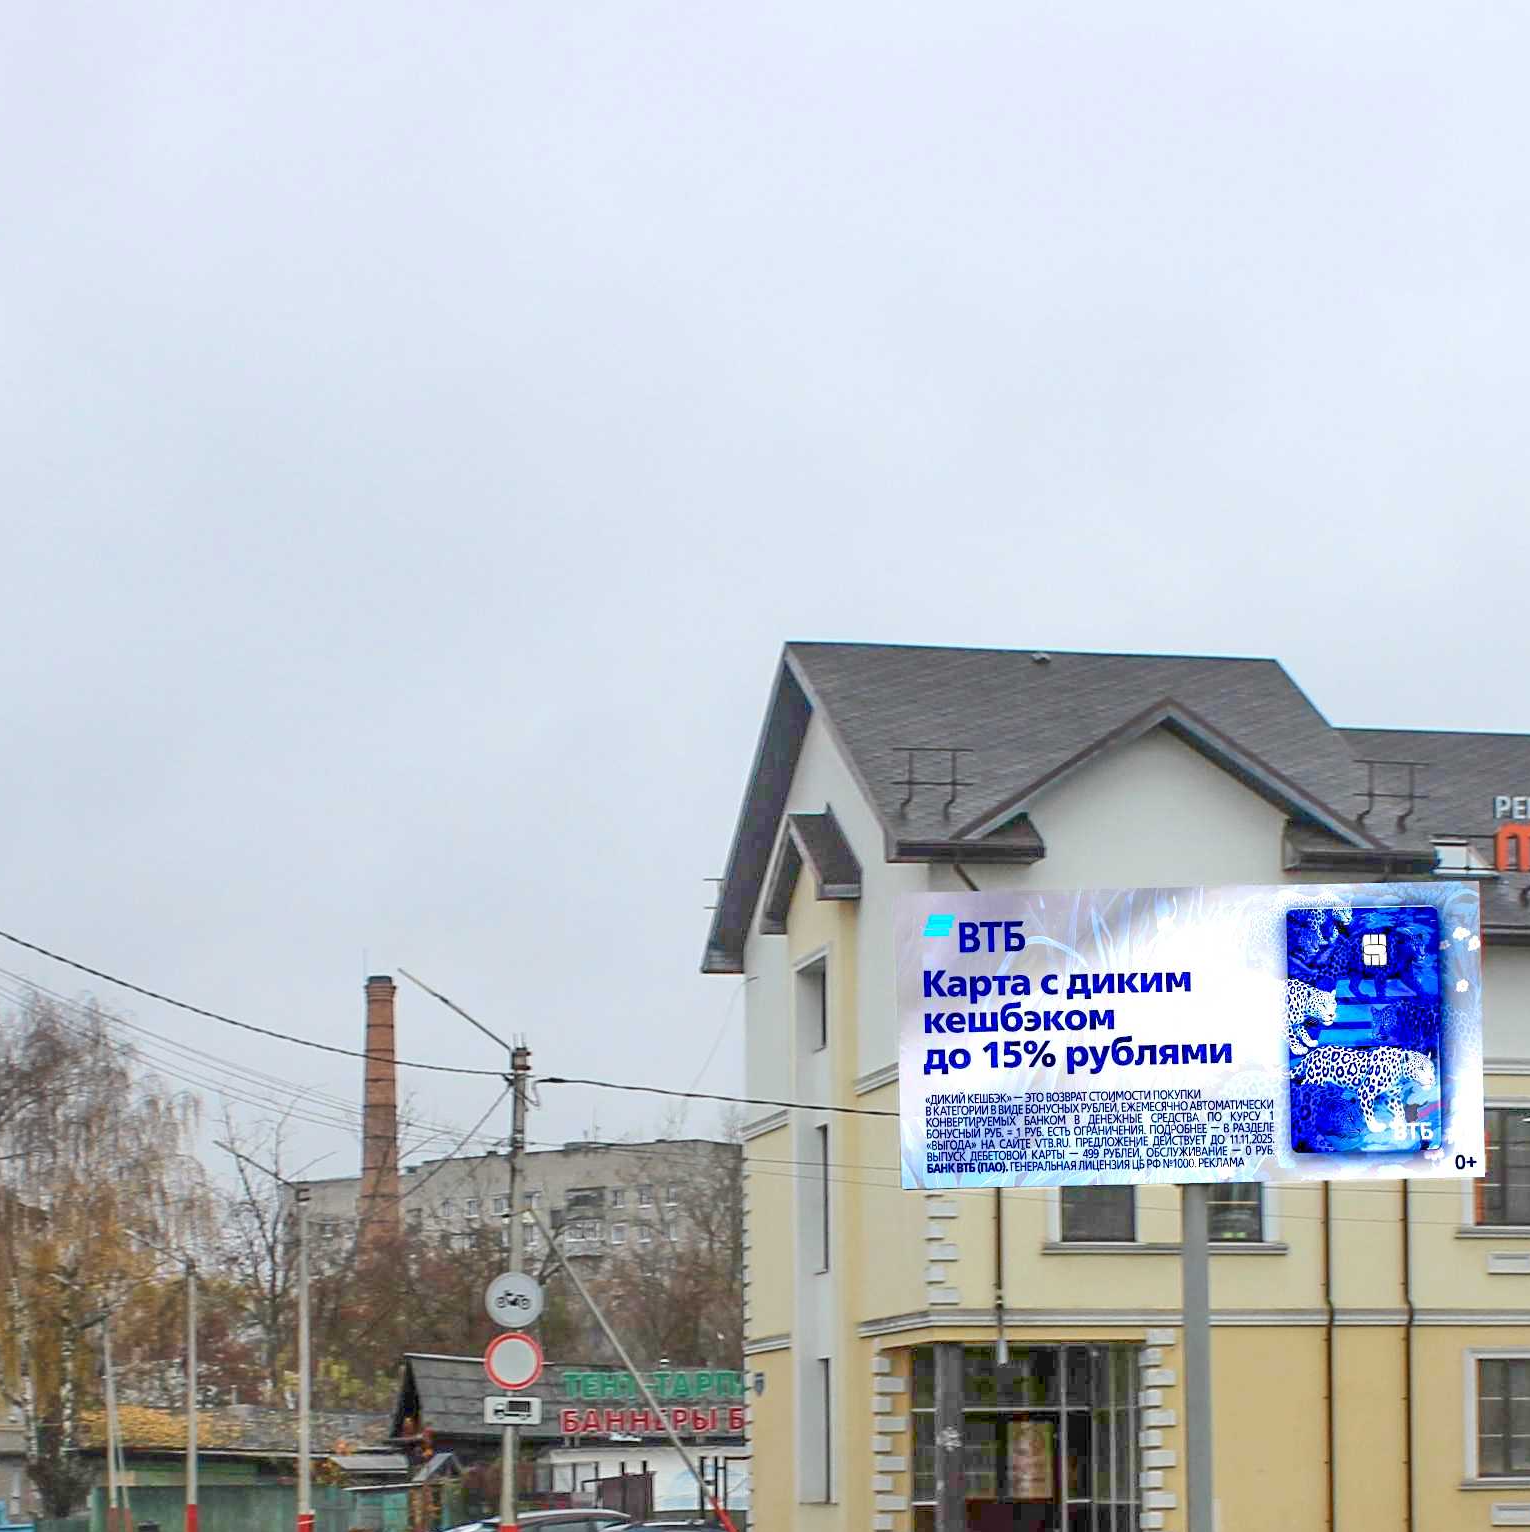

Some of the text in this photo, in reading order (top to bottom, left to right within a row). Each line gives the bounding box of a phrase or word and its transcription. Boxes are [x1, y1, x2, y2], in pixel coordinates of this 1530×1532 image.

[959, 920, 1026, 953] ВТБ
[923, 969, 1191, 1004] Карта с диким
[923, 1001, 1115, 1034] кешбэком
[923, 1035, 1233, 1075] до 15% рублями
[925, 1092, 966, 1105] «ДИКИЙ
[968, 1093, 1011, 1104] КЕШБЭК»
[1025, 1092, 1044, 1102] ЭТО
[1046, 1092, 1087, 1102] ВОЗВРАТ
[1089, 1090, 1150, 1102] СТОИМОСТИ
[1153, 1089, 1201, 1100] ПОКУПКИ
[925, 1100, 1274, 1116] В КАТЕГОРИИ В ВИДЕ БОНУСНЫХ РУБЛЕЙ, ЕЖЕМЕСЯЧНО АВТОМАТИЧЕСКИ
[926, 1111, 1274, 1128] КОНВЕРТИРУЕМЫХ БАНКОМ В ДЕНЕЖНЫЕ СРЕДСТВА ПО КУРСУ 1
[926, 1127, 981, 1139] БОНУСНЫЙ
[984, 1127, 1004, 1138] РУБ.
[1024, 1127, 1044, 1137] РУБ.
[1048, 1126, 1070, 1137] ЕСТЬ
[1074, 1124, 1146, 1136] ОГРАНИЧЕНИЯ.
[1149, 1123, 1207, 1136] ПОДРОБНЕЕ
[1223, 1123, 1229, 1133] В
[1233, 1122, 1275, 1134] РАЗДЕЛЕ
[1393, 1121, 1434, 1140] ВТБ
[926, 1139, 976, 1151] «ВЫГОДА»
[981, 1139, 995, 1149] НА
[999, 1136, 1031, 1149] САЙТЕ
[1035, 1137, 1071, 1148] VTB.RU.
[1075, 1136, 1148, 1148] ПРЕДЛОЖЕНИЕ
[1153, 1134, 1206, 1147] ДЕЙСТВУЕТ
[1210, 1135, 1225, 1146] ДО
[927, 1151, 966, 1162] ВЫПУСК
[970, 1149, 1027, 1162] ДЕБЕТОВОЙ
[1031, 1149, 1065, 1160] КАРТЫ
[1082, 1148, 1099, 1159] 499
[1103, 1146, 1142, 1159] РУБЛЕЙ,
[1146, 1145, 1228, 1158] ОБСЛУЖИВАНИЕ
[1245, 1145, 1252, 1155] 0
[1256, 1144, 1275, 1155] РУБ.
[1455, 1154, 1477, 1170] 0+
[927, 1162, 955, 1174] БАНК
[956, 1162, 976, 1173] ВТБ
[977, 1161, 1009, 1175] (ПАО).
[1010, 1160, 1077, 1172] ГЕНЕРАЛЬНАЯ
[1079, 1159, 1130, 1171] ЛИЦЕНЗИЯ
[1132, 1159, 1145, 1171] ЦБ
[1147, 1158, 1161, 1169] РФ
[1198, 1157, 1245, 1168] РЕКЛАМА
[560, 1407, 718, 1433] БАННЕРЫ
